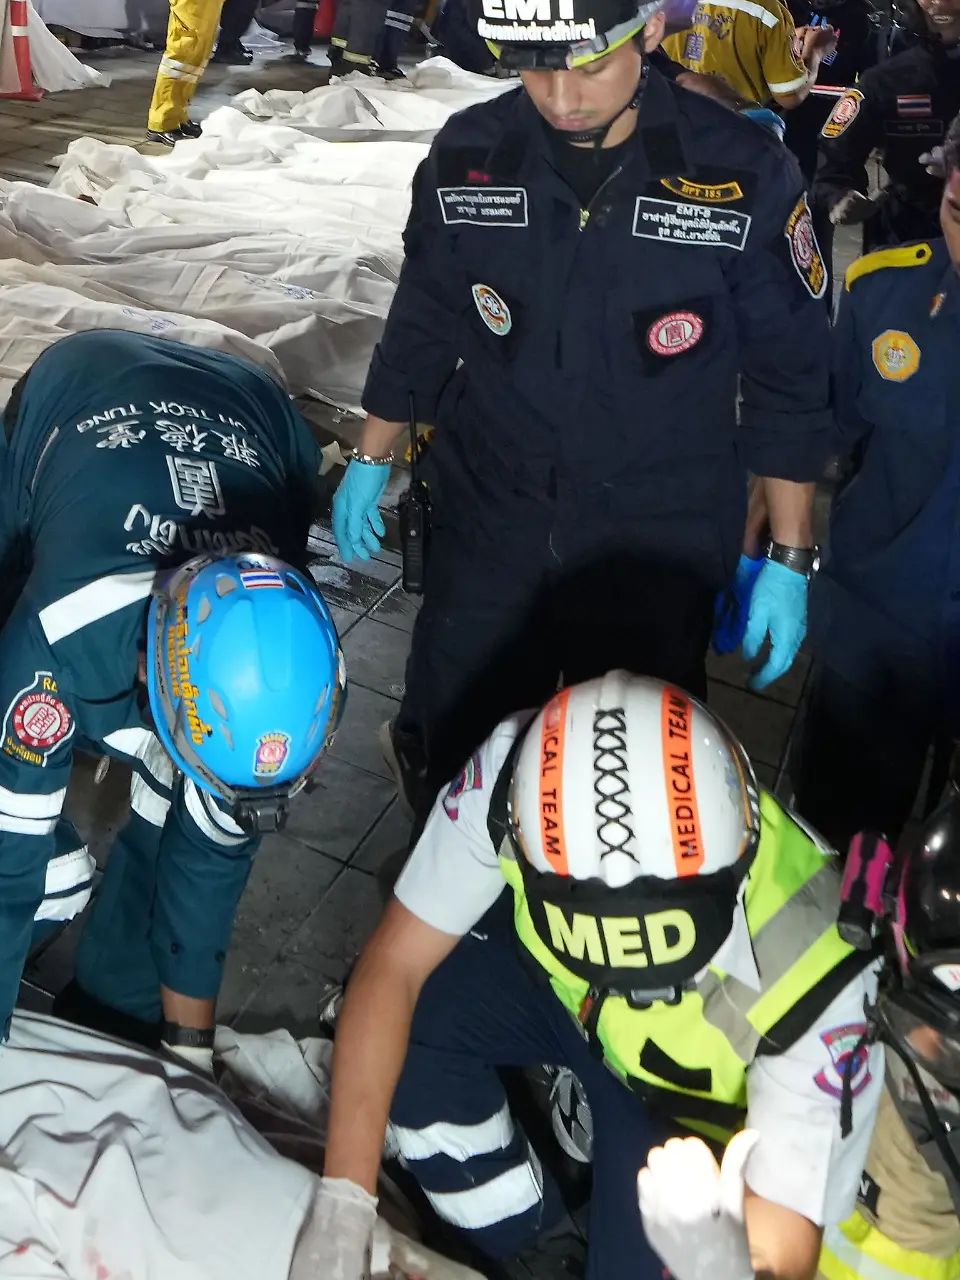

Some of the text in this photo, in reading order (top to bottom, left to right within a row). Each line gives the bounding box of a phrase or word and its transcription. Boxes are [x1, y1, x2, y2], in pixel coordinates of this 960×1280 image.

[76, 401, 215, 434] TECK TUNG
[668, 693, 699, 859] MEDICAL TEAM
[542, 788, 561, 856] TEAM
[542, 899, 697, 969] MED
